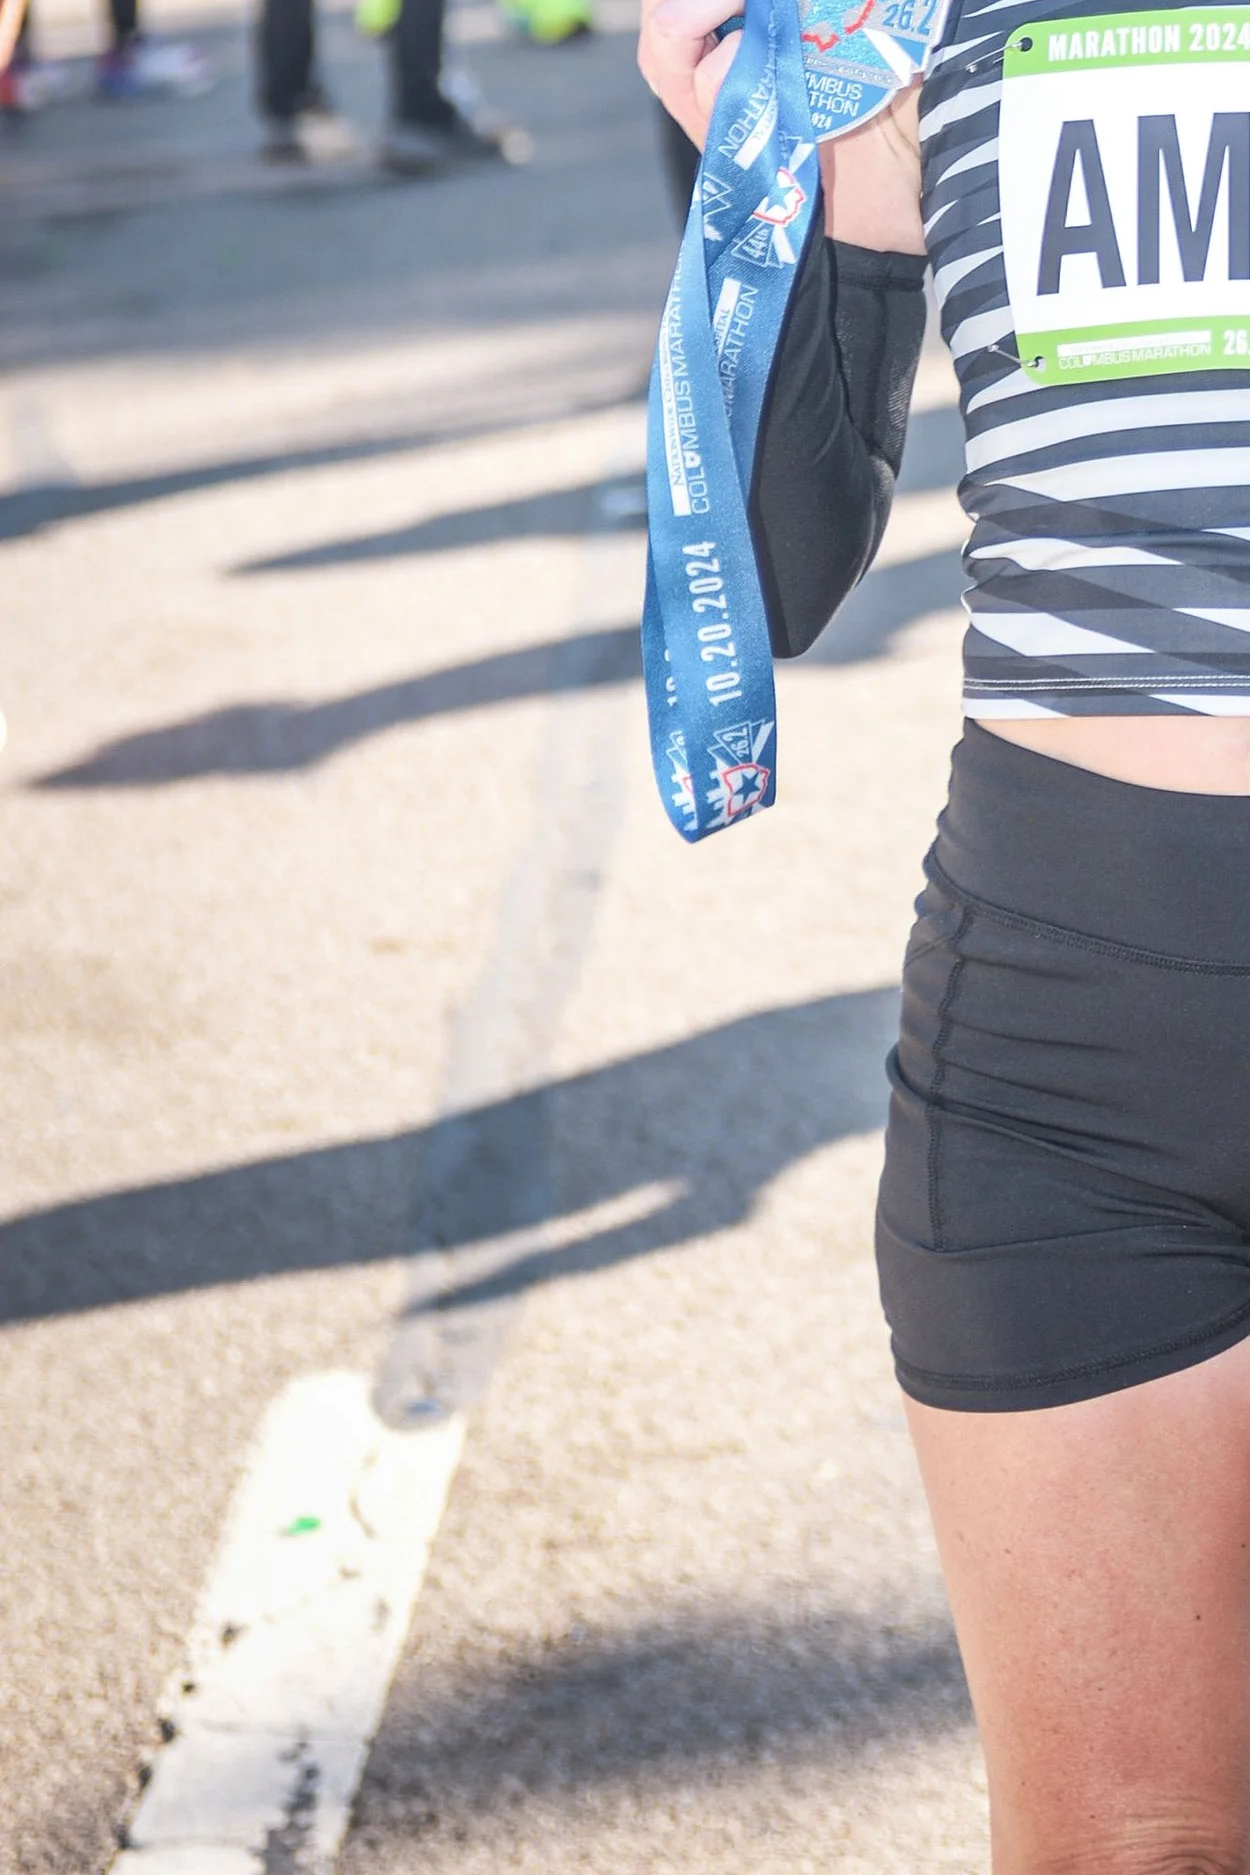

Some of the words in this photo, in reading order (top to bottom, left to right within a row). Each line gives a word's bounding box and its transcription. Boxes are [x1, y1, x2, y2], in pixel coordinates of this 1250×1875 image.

[1048, 23, 1180, 62] MARATHON
[742, 228, 770, 259] 44th
[1058, 351, 1131, 371] COLUMBUS
[1132, 344, 1211, 364] MARATHON
[674, 381, 710, 514] COLUMBUS
[682, 541, 743, 707] 10.20.2024
[722, 726, 750, 758] 26.2
